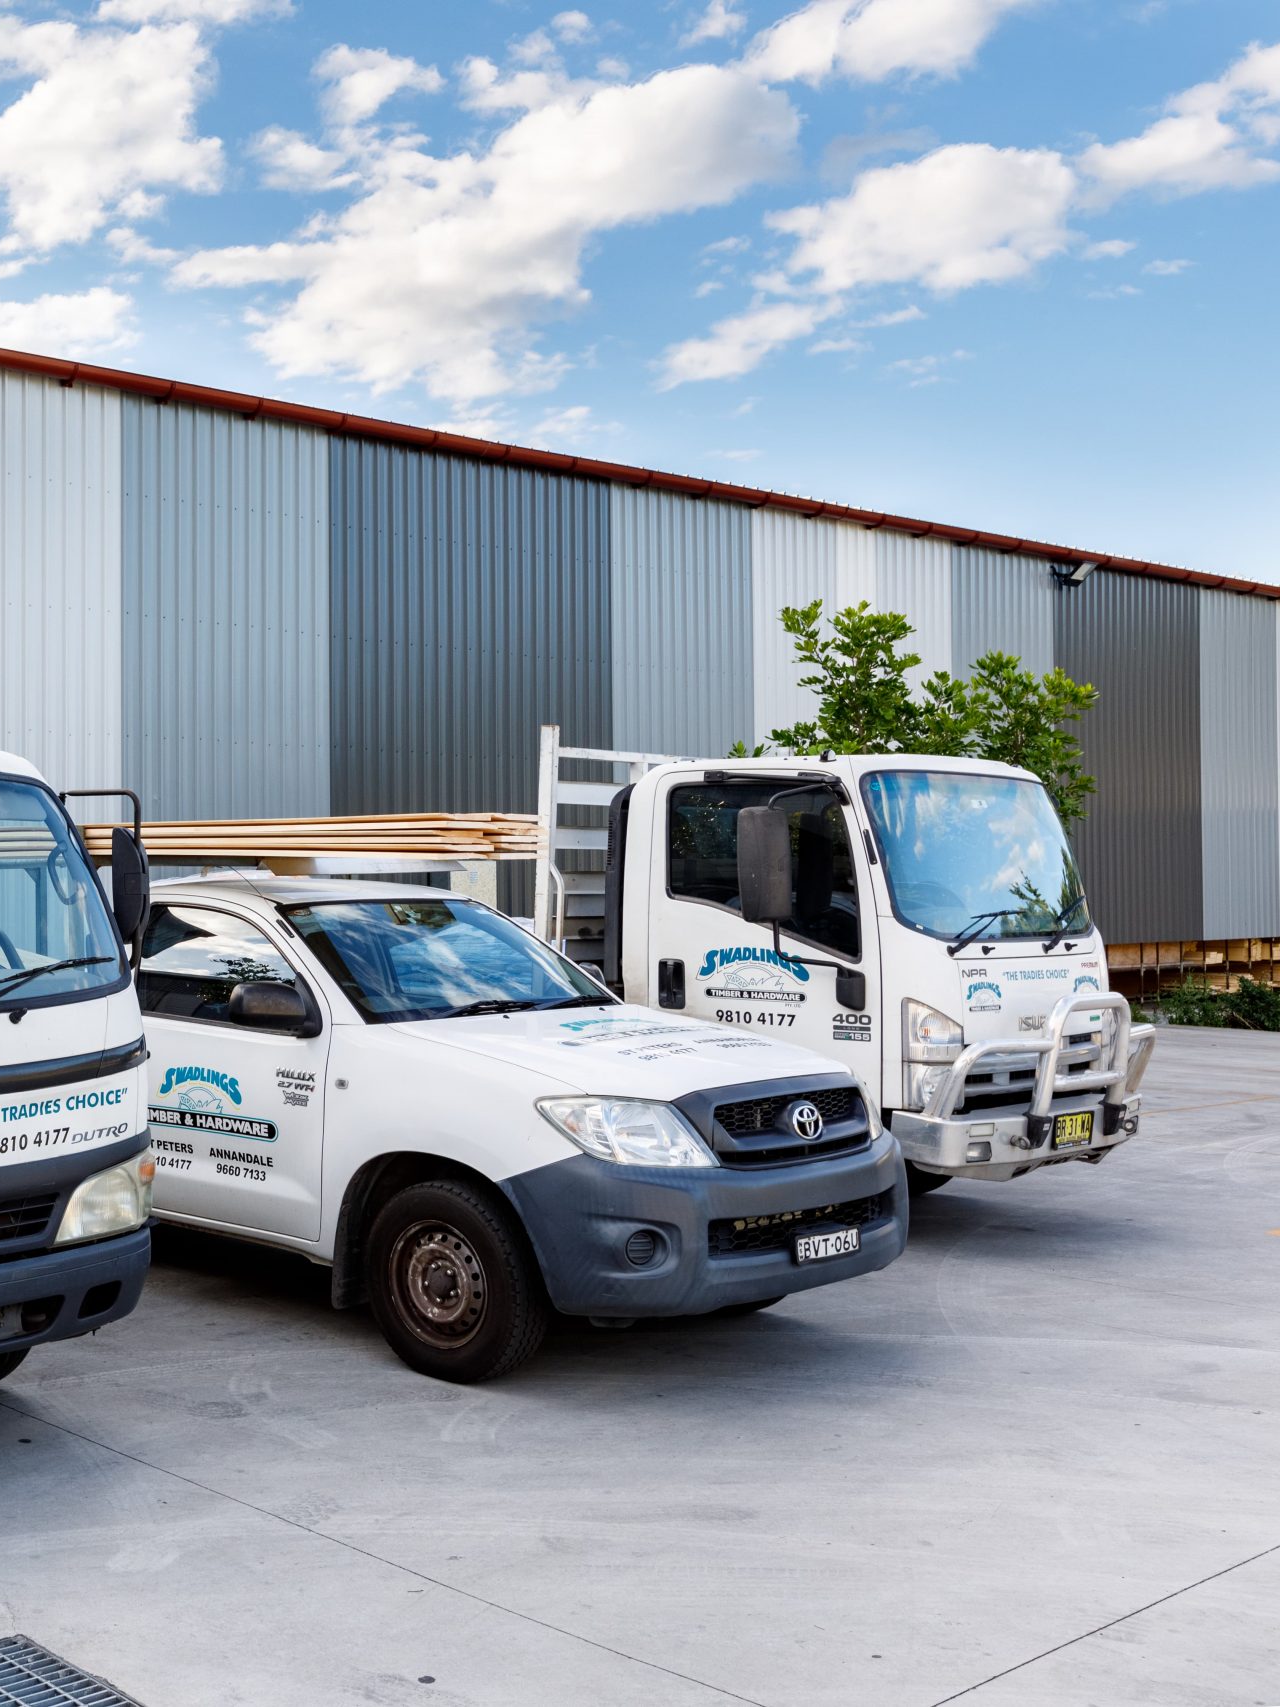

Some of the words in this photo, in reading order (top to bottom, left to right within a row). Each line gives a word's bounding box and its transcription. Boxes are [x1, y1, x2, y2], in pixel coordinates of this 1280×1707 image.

[699, 947, 810, 982] SWADLINGS
[961, 968, 987, 978] NPR
[1020, 970, 1044, 980] TRADIES
[710, 989, 741, 998] TIMBER
[742, 990, 749, 998] &
[750, 991, 801, 1001] HARDWARE
[716, 1010, 752, 1024] 9810
[757, 1012, 796, 1026] 4177
[832, 1013, 872, 1025] 400
[160, 1066, 242, 1105] SWADLINGS
[1, 1099, 61, 1122] TRADIES
[148, 1109, 182, 1126] IMBER
[184, 1113, 194, 1126] &
[196, 1116, 269, 1138] HARDWARE
[33, 1127, 70, 1148] 4177
[71, 1122, 129, 1145] DUTRO
[156, 1140, 194, 1155] PETERS
[168, 1156, 192, 1171] 4177
[209, 1147, 274, 1168] ANNANDALE
[216, 1163, 241, 1177] 9660
[243, 1168, 267, 1182] 7133
